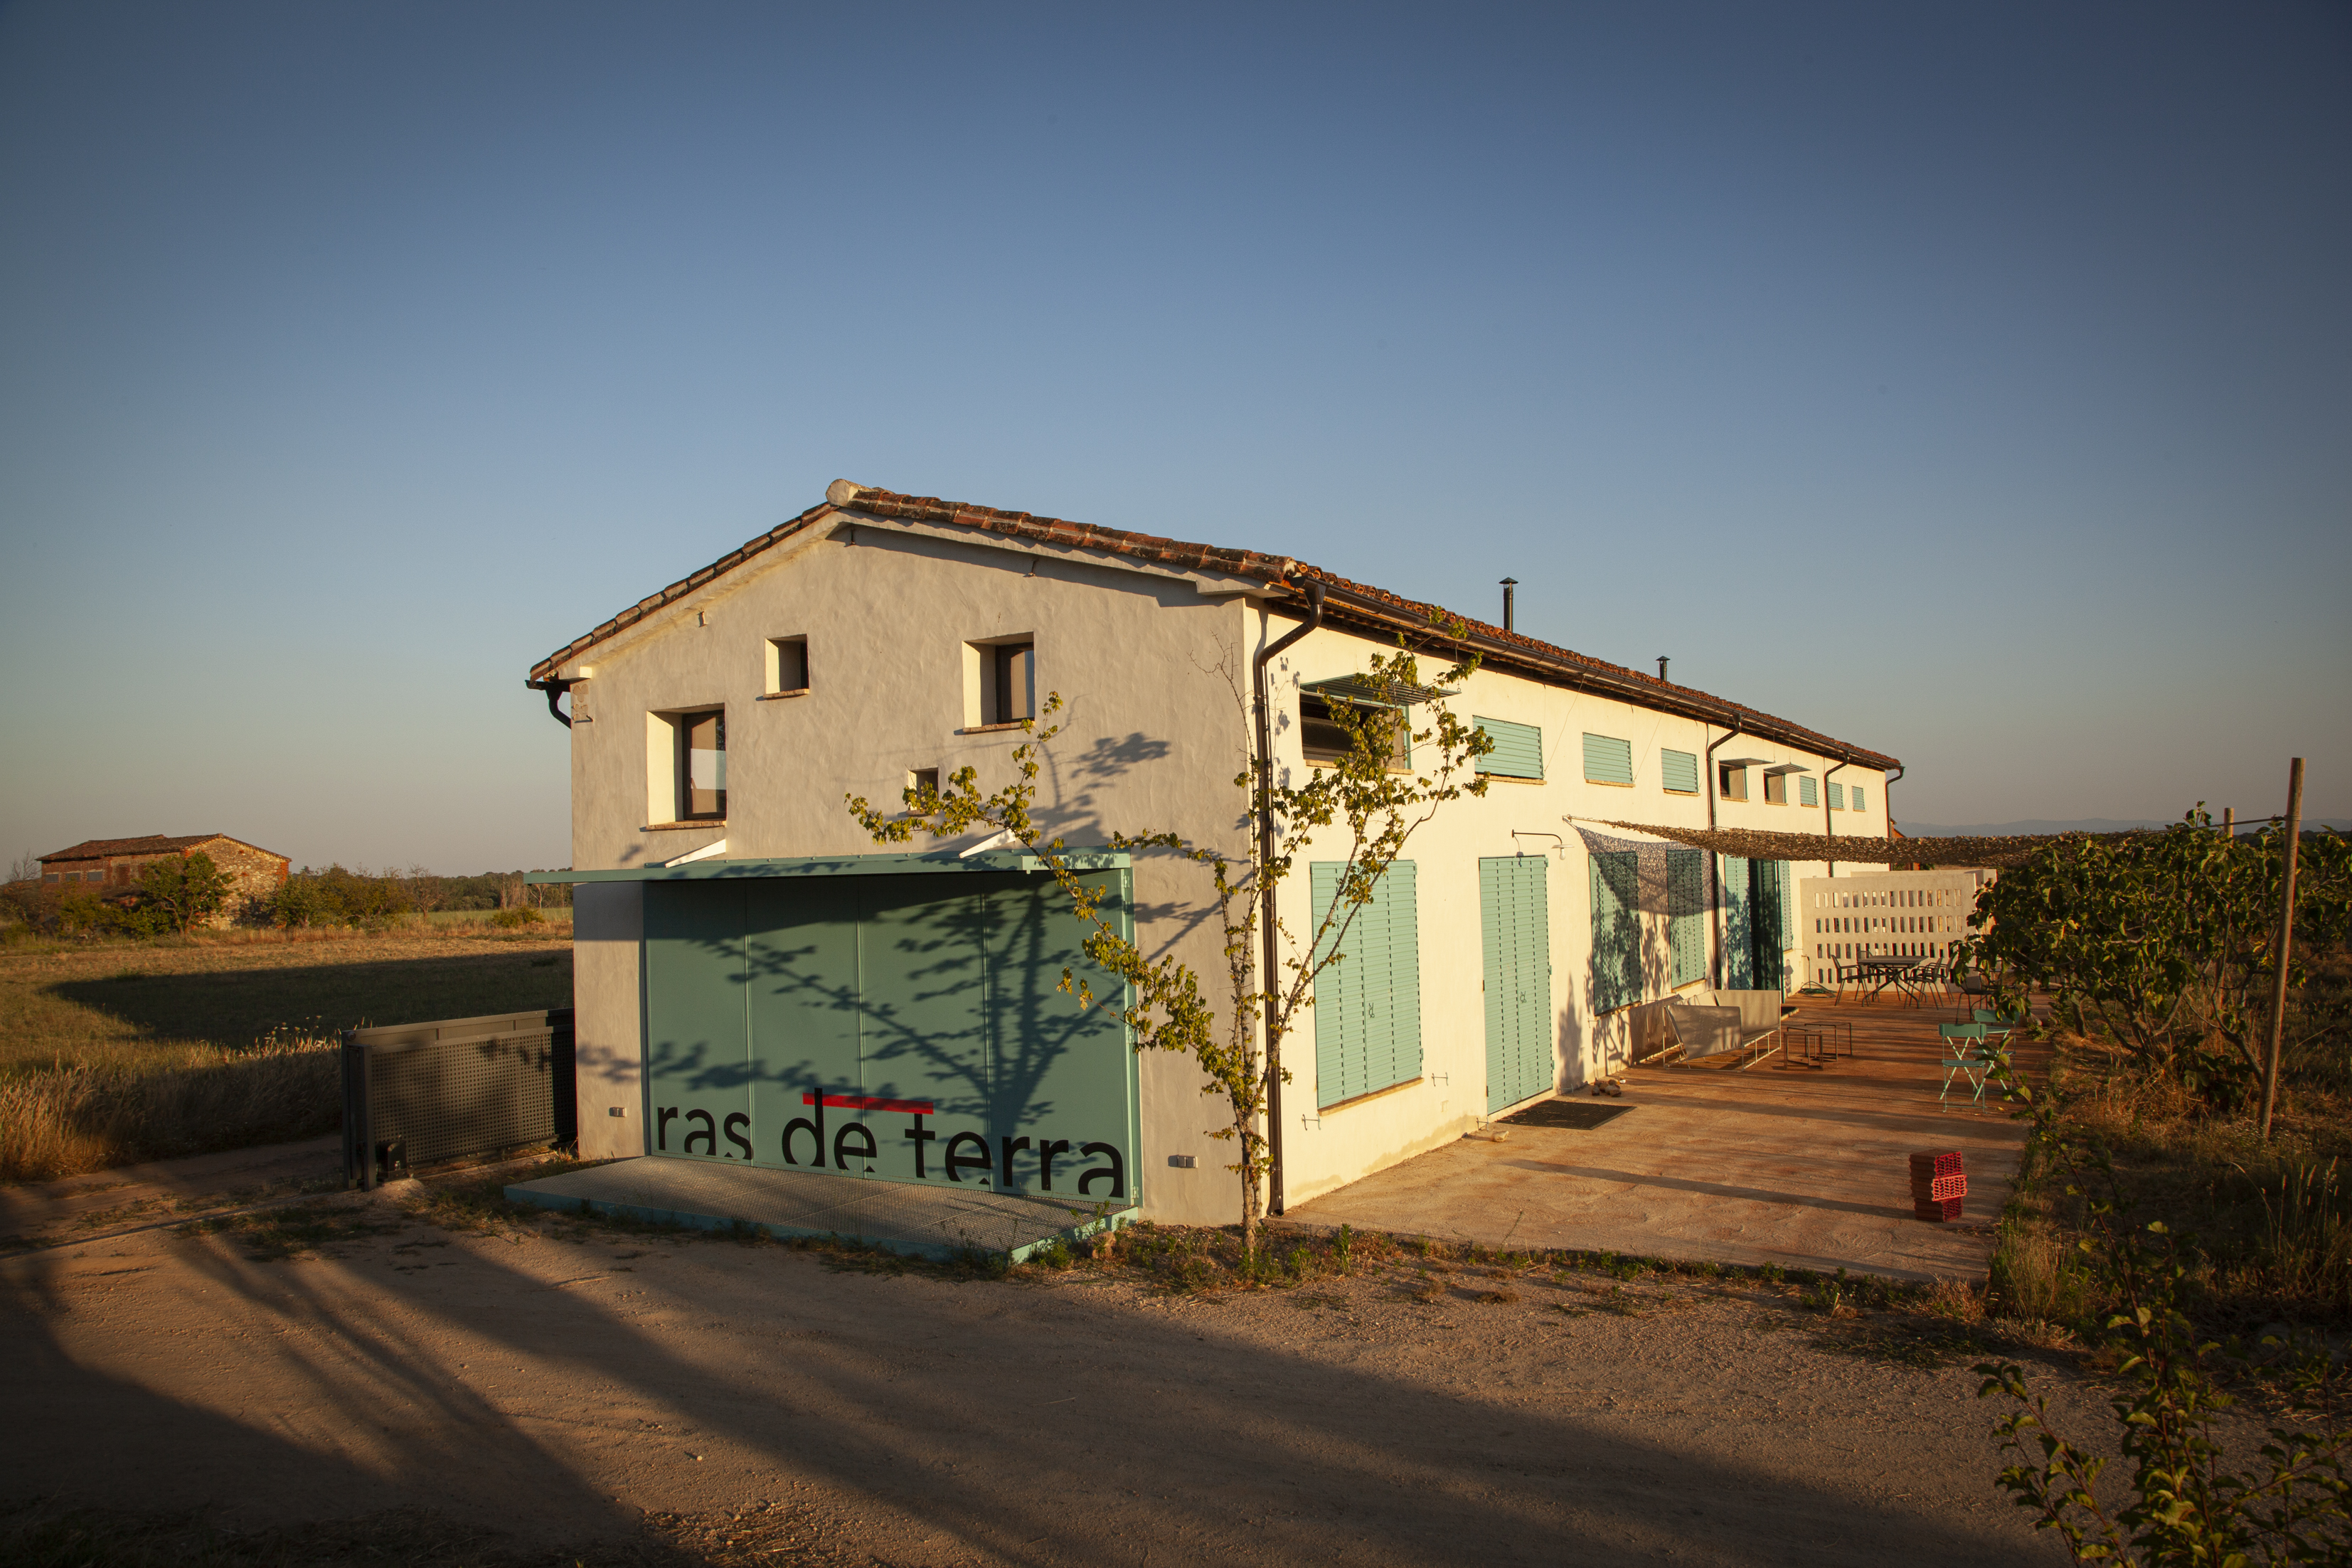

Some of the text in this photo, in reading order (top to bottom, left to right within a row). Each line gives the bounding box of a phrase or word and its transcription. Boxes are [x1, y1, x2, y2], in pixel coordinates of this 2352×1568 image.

[657, 1087, 1124, 1198] ras de terra
